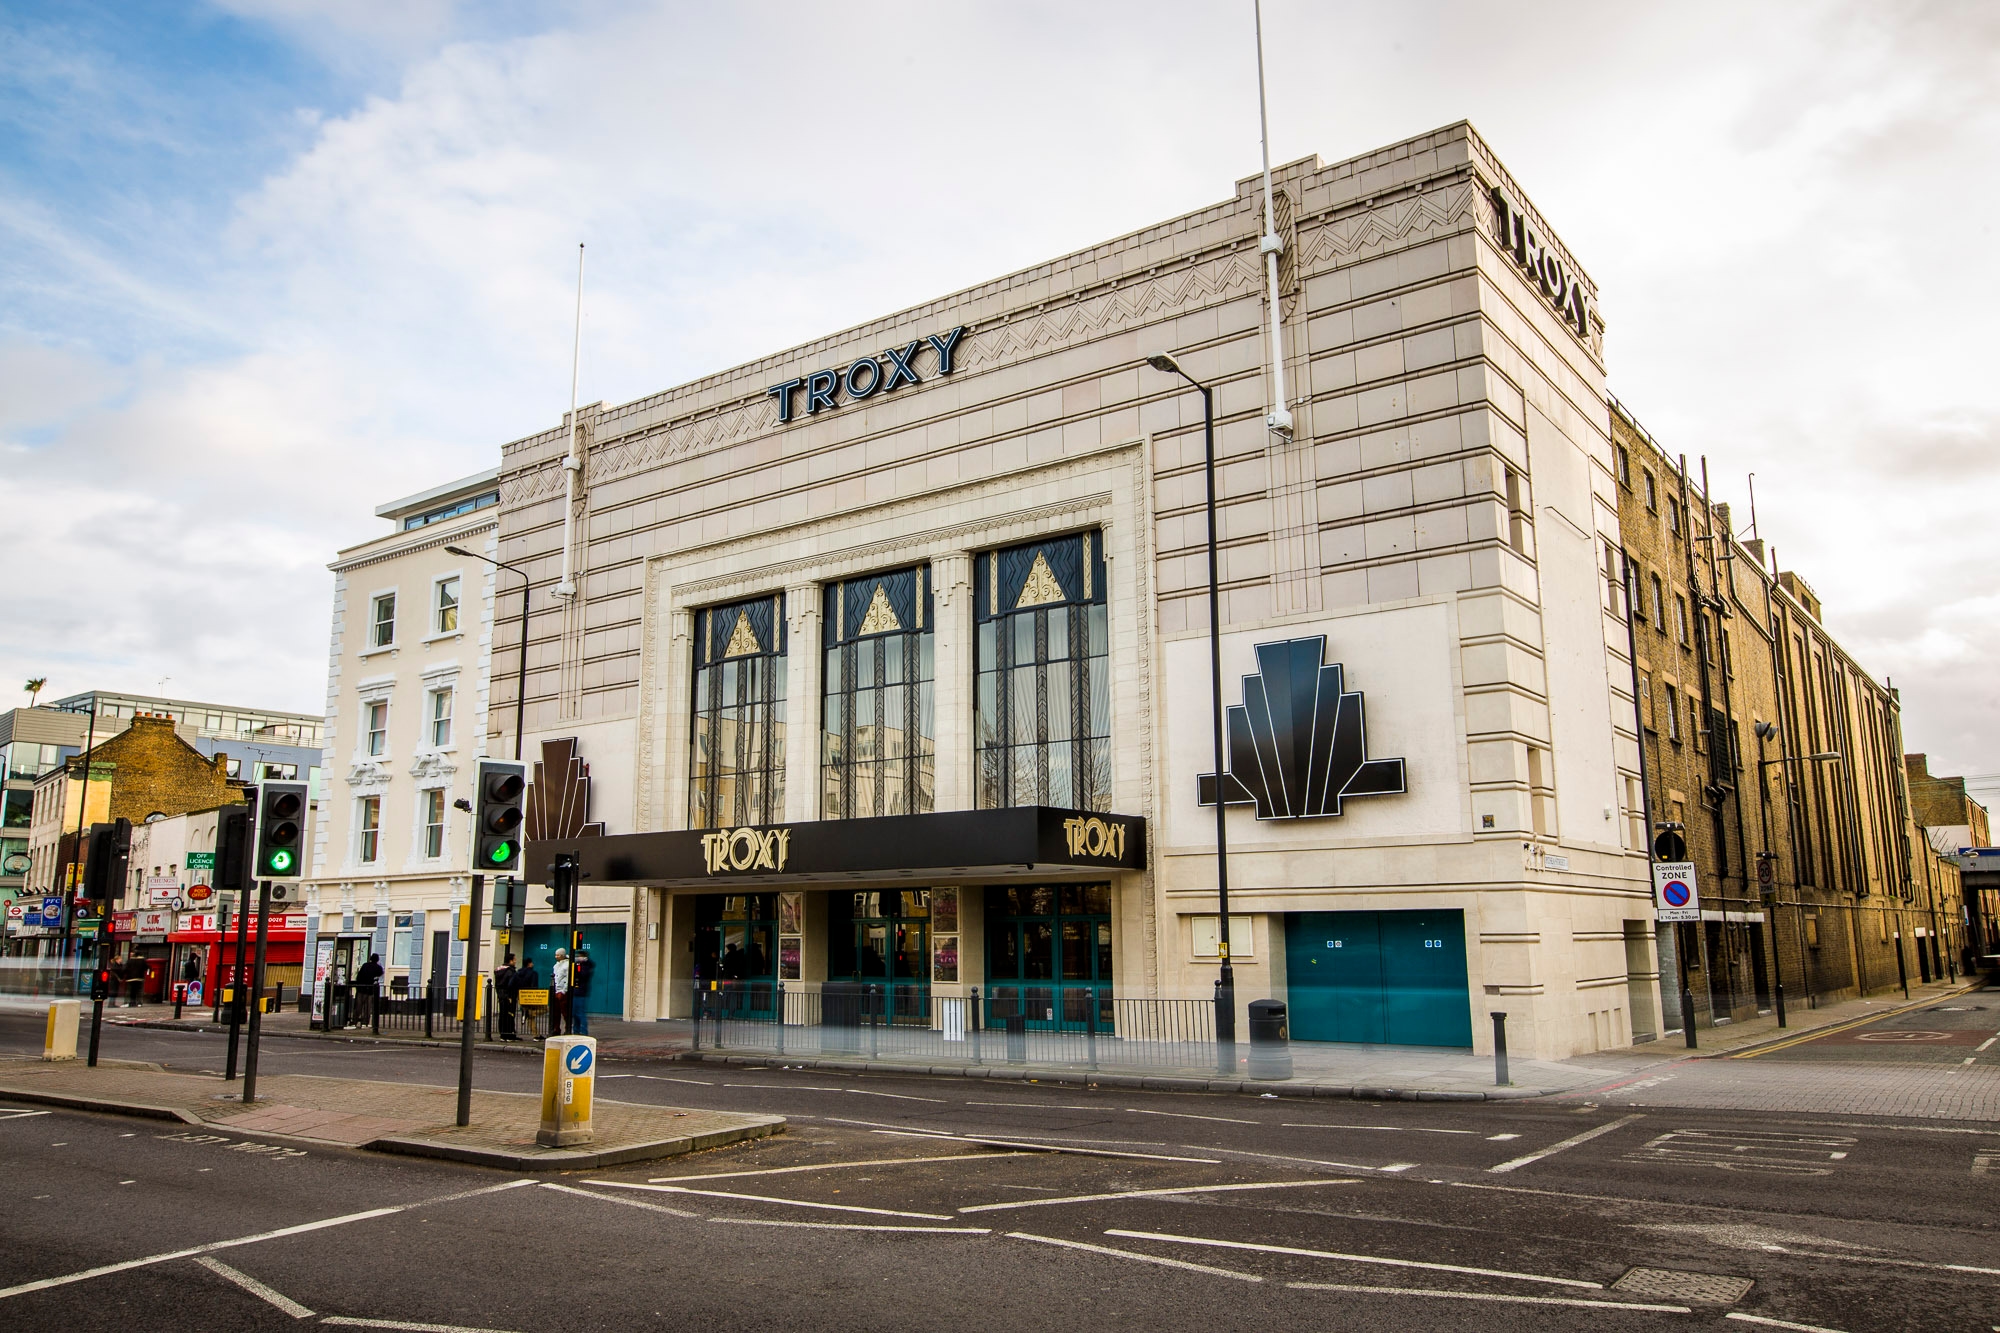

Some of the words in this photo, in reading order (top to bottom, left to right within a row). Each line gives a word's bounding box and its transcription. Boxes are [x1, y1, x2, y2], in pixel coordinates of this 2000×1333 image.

[1491, 186, 1592, 338] TROXY
[768, 325, 966, 423] TROXY
[700, 826, 792, 875] TROXY
[1063, 816, 1126, 861] TROXY
[1655, 864, 1692, 872] Controlled
[1760, 867, 1770, 877] 20
